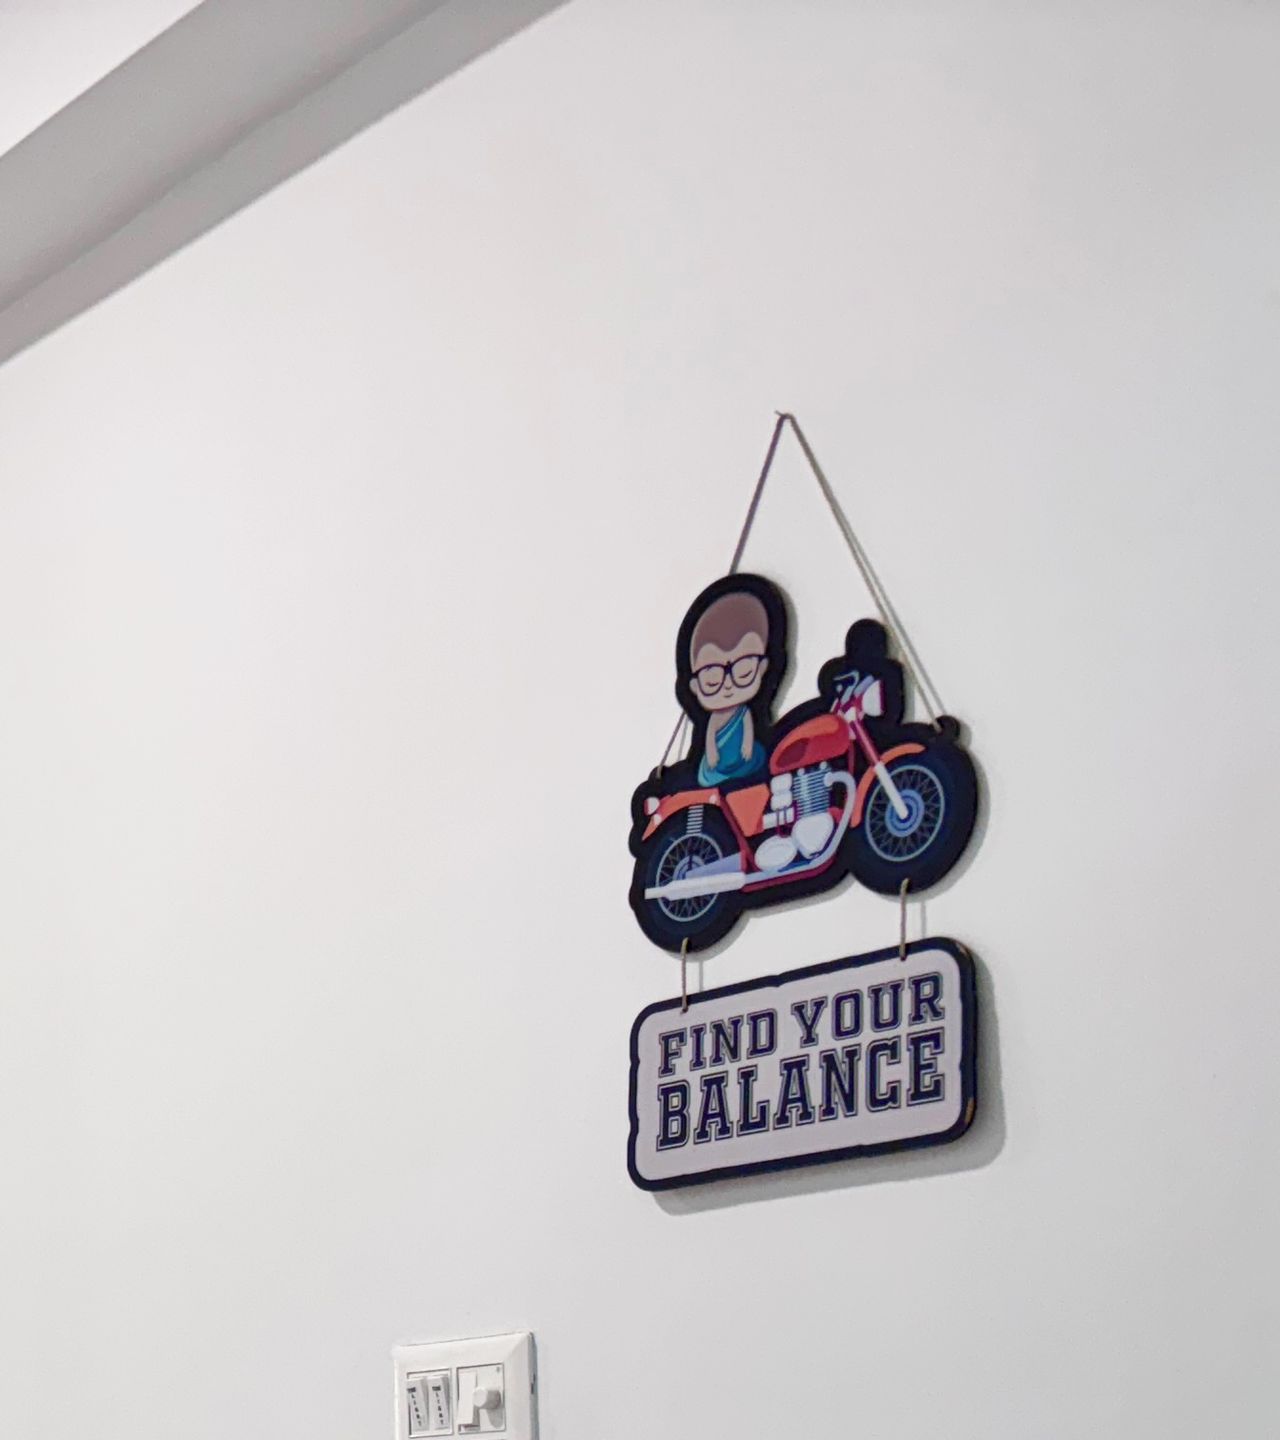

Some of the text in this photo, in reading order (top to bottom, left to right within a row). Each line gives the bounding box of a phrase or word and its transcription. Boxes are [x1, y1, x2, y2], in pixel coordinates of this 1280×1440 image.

[658, 971, 946, 1079] FIND YOUR
[656, 1027, 945, 1152] BALANCE
